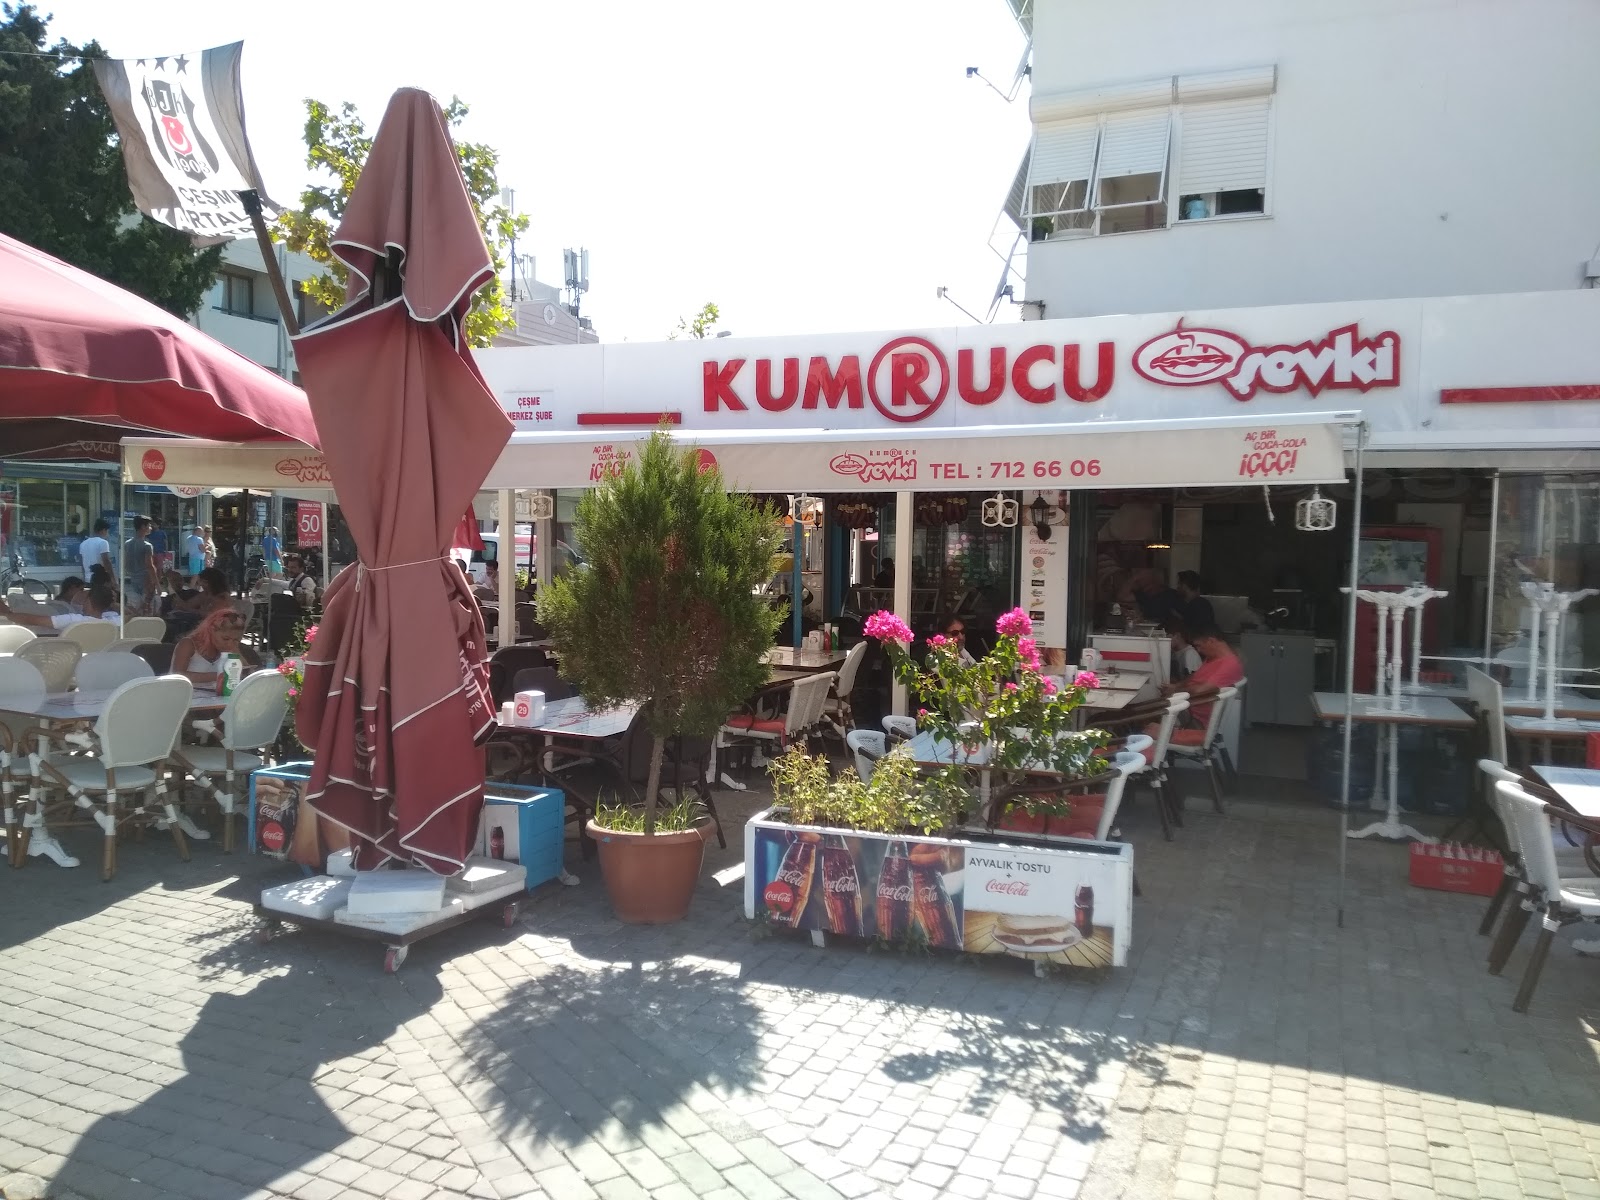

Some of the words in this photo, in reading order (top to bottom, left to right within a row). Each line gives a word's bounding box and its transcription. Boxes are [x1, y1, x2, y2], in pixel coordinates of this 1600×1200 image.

[147, 86, 186, 114] BJK
[172, 158, 210, 174] 1903
[702, 336, 1116, 422] KUMRUCU
[517, 397, 541, 409] ÇEŞME
[535, 411, 553, 423] ŞUBE
[1244, 431, 1258, 443] AÇ
[1260, 429, 1276, 441] BİR
[592, 445, 602, 454] AÇ
[602, 444, 613, 453] BİR
[1253, 438, 1307, 450] COCA-COLA
[929, 463, 970, 479] TEL
[990, 461, 1025, 479] 712
[1033, 460, 1062, 478] 66
[1070, 458, 1102, 477] 06
[301, 514, 320, 533] 50
[517, 705, 527, 715] 29
[969, 857, 1013, 870] AYVALIK
[1016, 862, 1052, 874] TOSTU
[985, 878, 1031, 897] Coca-Cola
[765, 890, 791, 903] Coca-Cola
